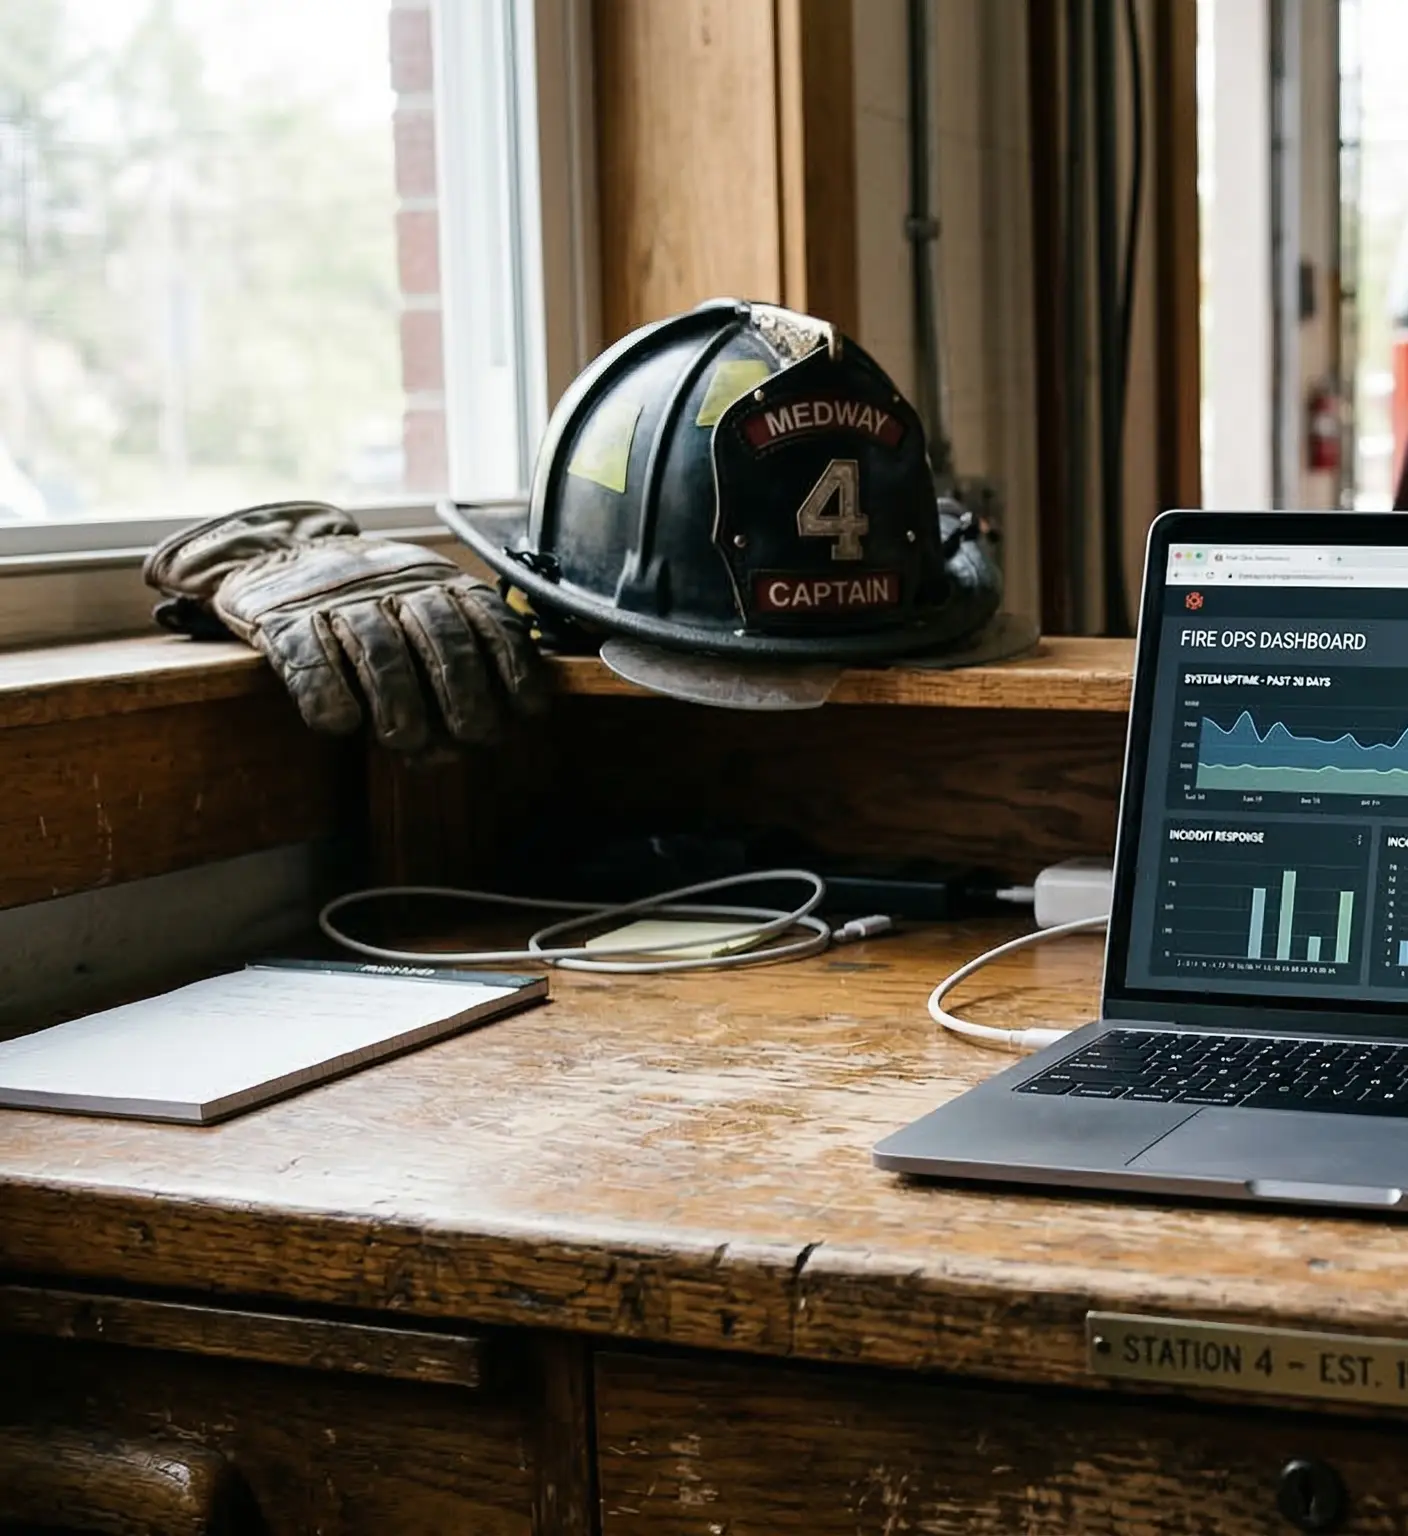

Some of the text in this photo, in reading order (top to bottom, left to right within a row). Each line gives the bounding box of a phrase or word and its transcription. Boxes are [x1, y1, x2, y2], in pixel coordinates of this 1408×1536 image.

[764, 401, 889, 437] MEDWAY
[797, 458, 869, 560] 4
[769, 578, 889, 607] CAPTAIN
[1180, 630, 1367, 650] FIRE OPS DASHBOARD
[1184, 673, 1222, 685] SYSTEM
[1266, 675, 1292, 686] PAST
[1306, 676, 1332, 688] DAYS
[1123, 1335, 1242, 1375] STATION
[1254, 1348, 1274, 1378] 4
[1319, 1351, 1382, 1389] EST.
